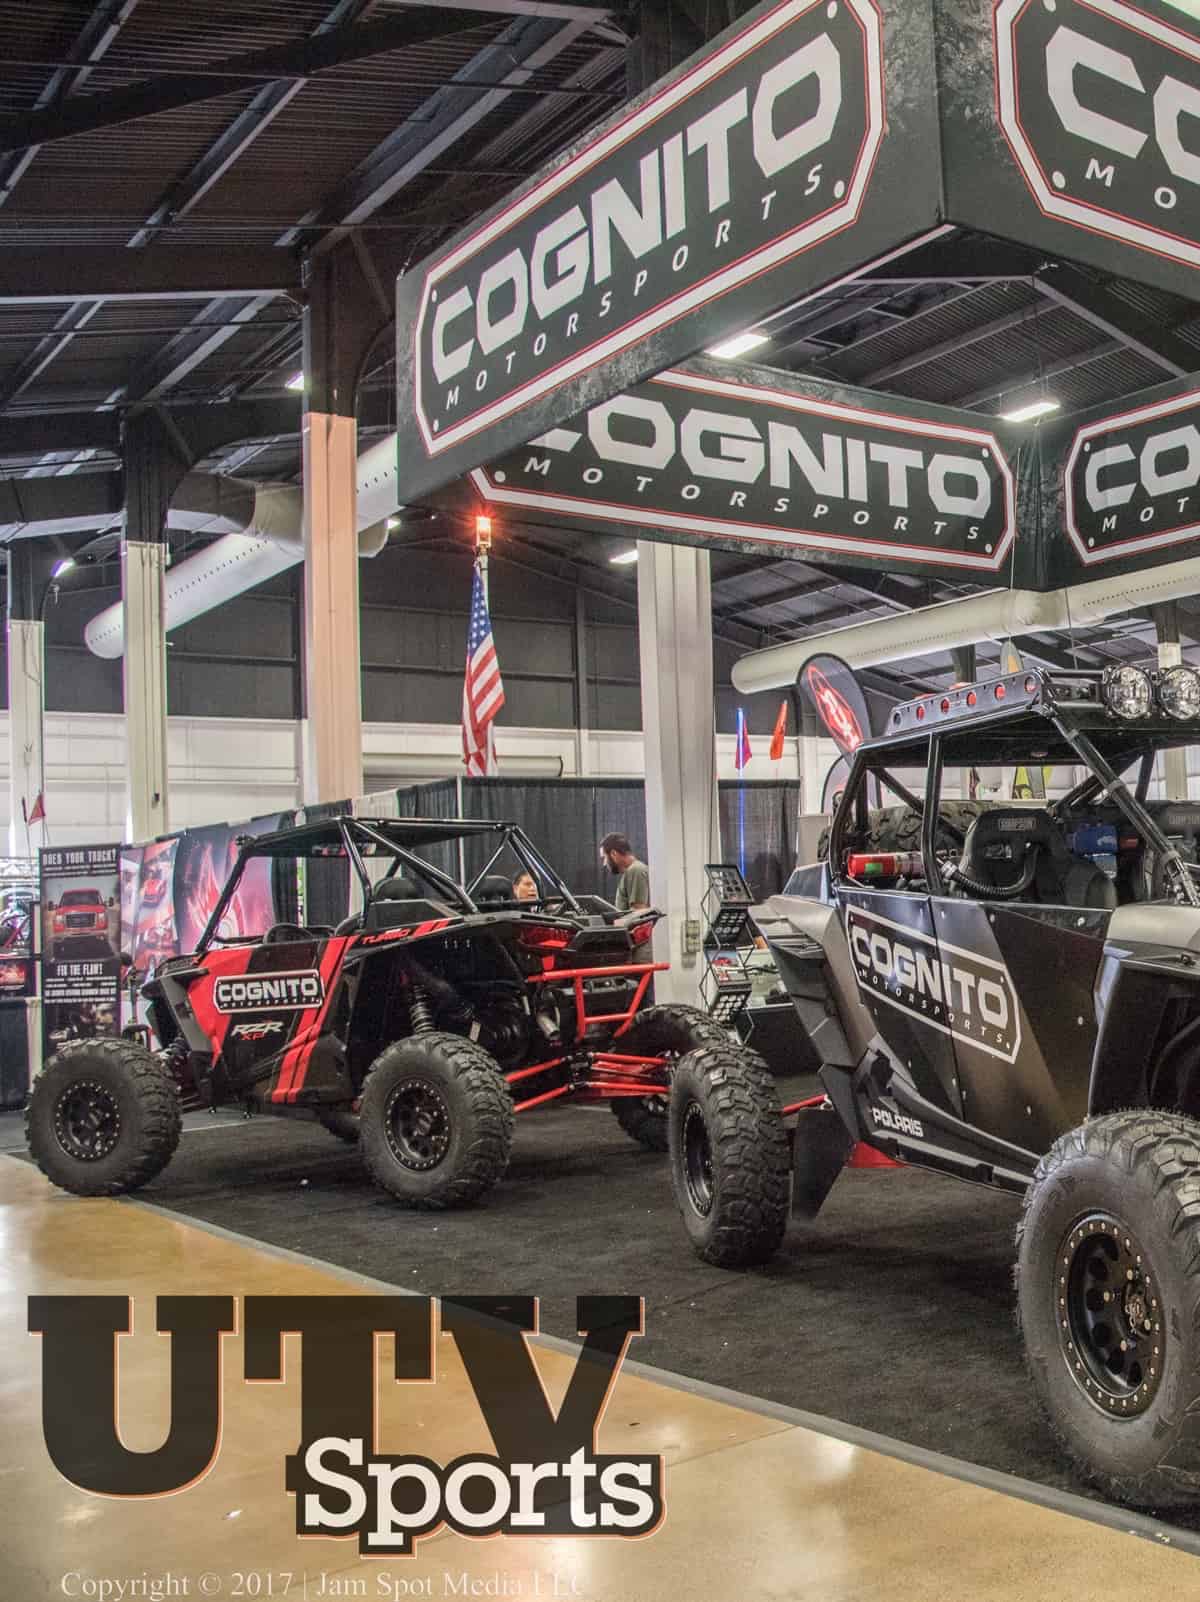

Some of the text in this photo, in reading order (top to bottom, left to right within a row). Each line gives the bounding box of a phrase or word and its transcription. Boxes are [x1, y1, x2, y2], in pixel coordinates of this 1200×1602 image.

[432, 32, 841, 384] COGNITO
[446, 163, 823, 409] MOTORSPORTS
[524, 456, 979, 540] MOTORSPORTS
[527, 393, 991, 519] OGNITO
[218, 978, 318, 1001] COGNITO
[852, 925, 1008, 1029] COGNITO
[860, 970, 1003, 1043] MOTORSPORTS
[231, 1020, 284, 1037] RZR
[872, 1107, 923, 1137] POLARIS
